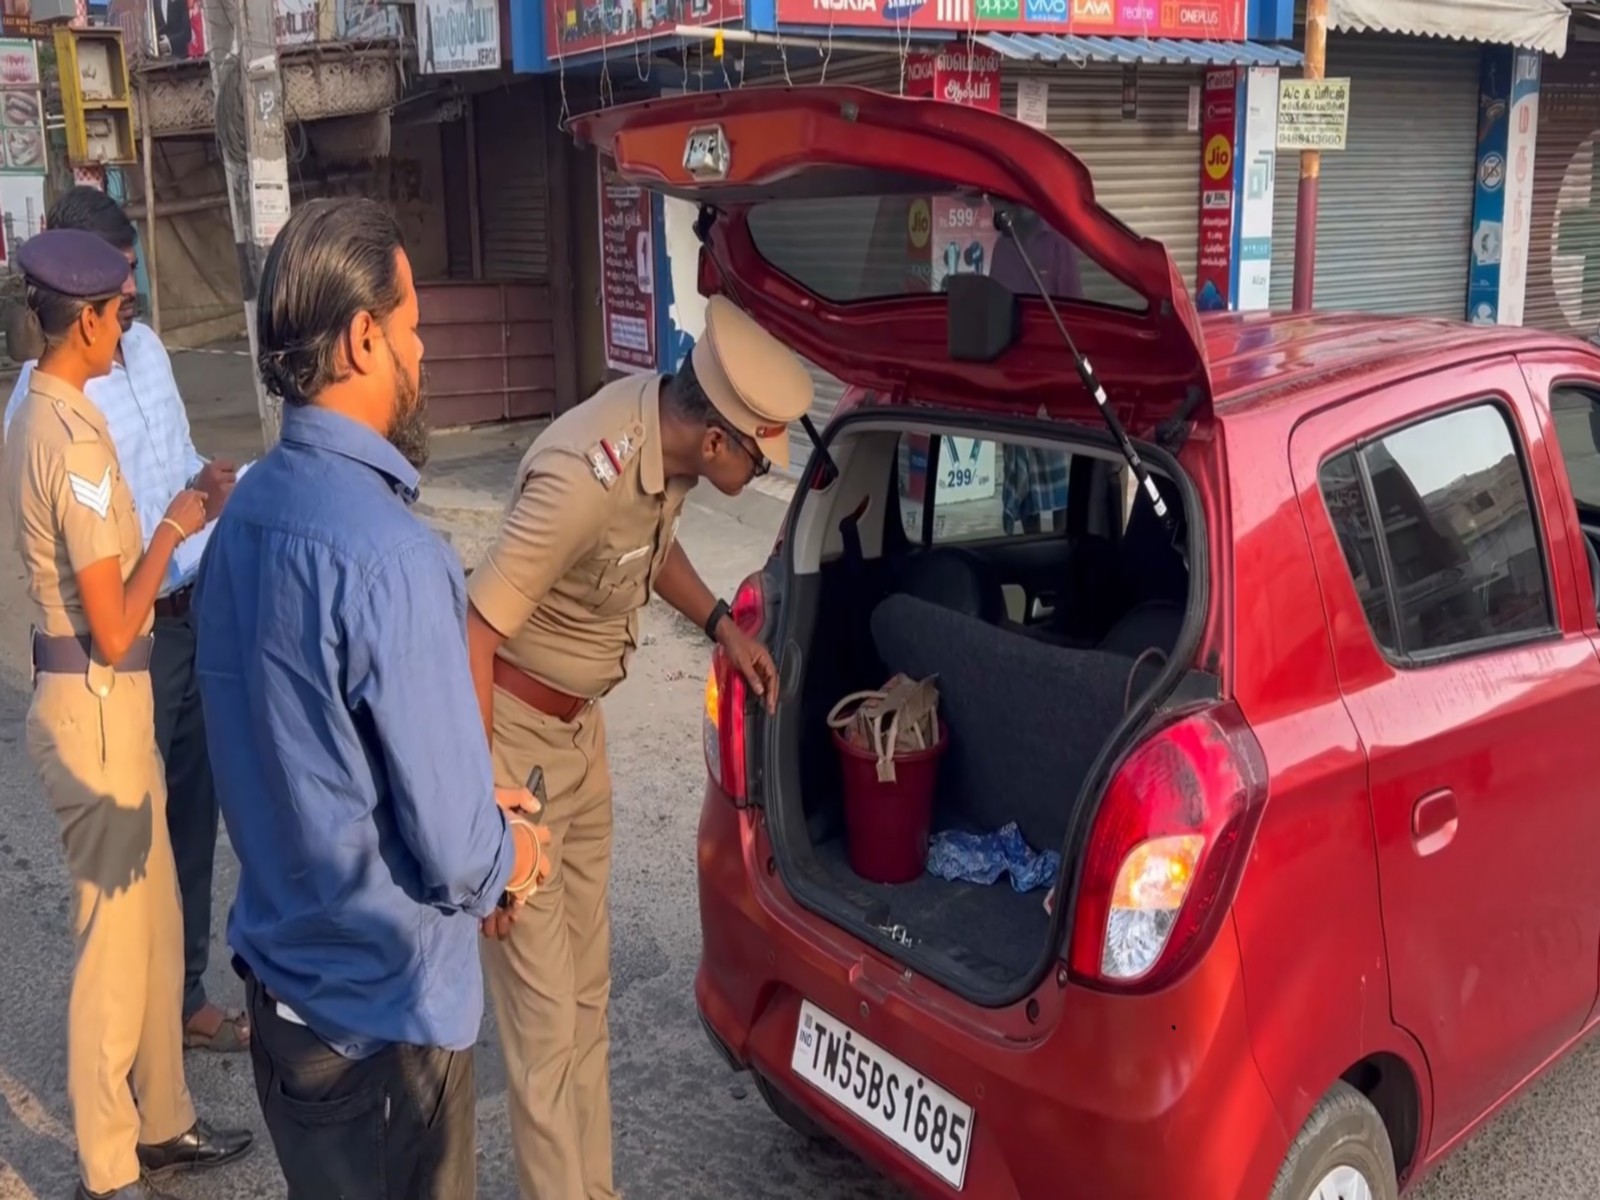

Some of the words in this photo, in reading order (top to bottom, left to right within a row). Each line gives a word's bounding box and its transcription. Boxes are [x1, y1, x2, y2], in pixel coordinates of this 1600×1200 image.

[1180, 9, 1219, 25] ONEPLUS
[1208, 145, 1229, 166] Jio
[812, 1022, 966, 1166] TN55BS1685
